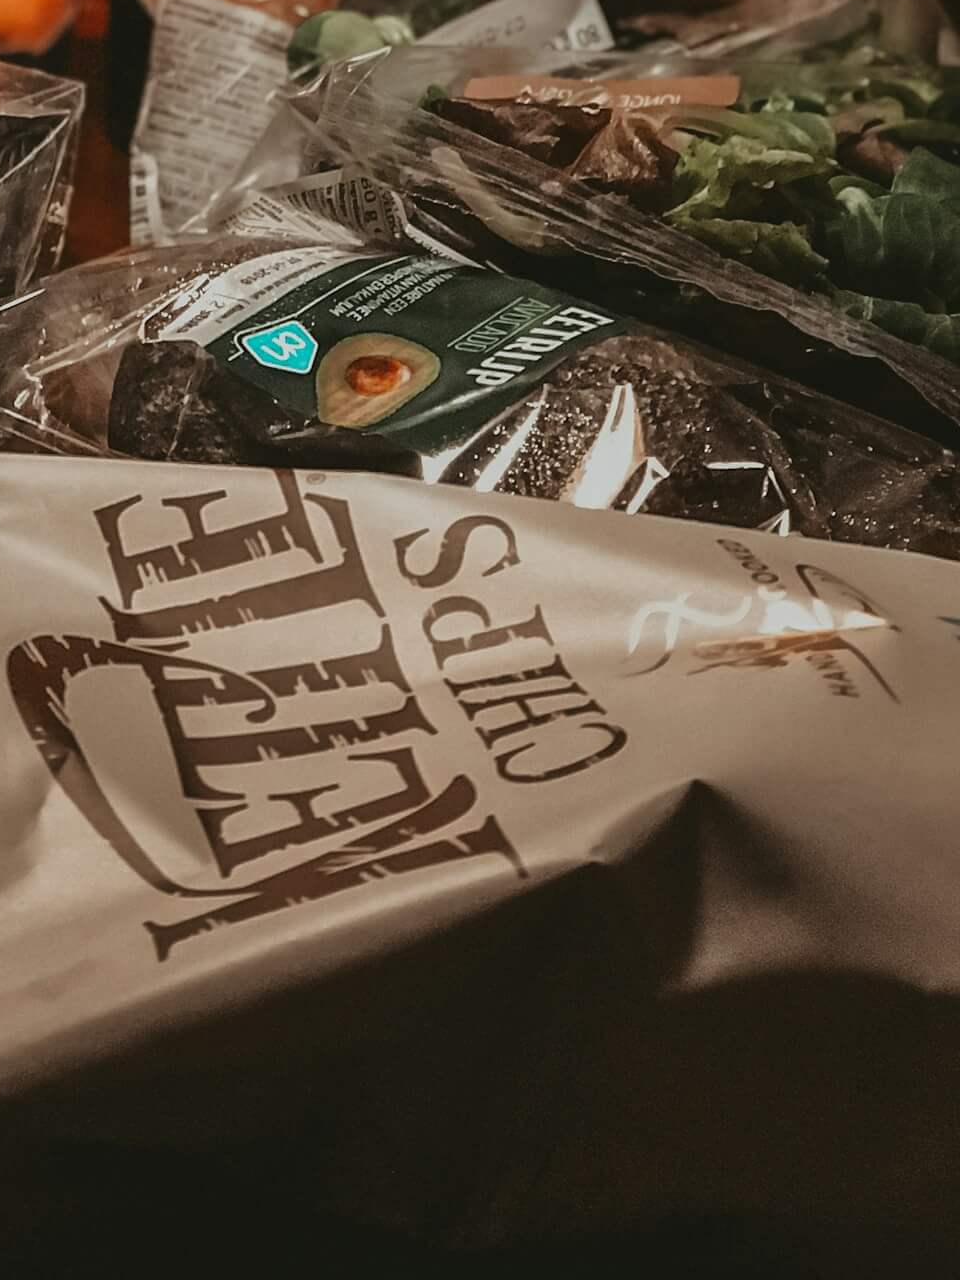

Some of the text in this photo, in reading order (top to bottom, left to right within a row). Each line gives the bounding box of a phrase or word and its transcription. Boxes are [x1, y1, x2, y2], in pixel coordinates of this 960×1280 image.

[453, 297, 552, 353] AVOCADO
[465, 306, 615, 386] EETRIJP
[6, 470, 529, 962] KETTLE
[392, 515, 628, 783] CHIPS
